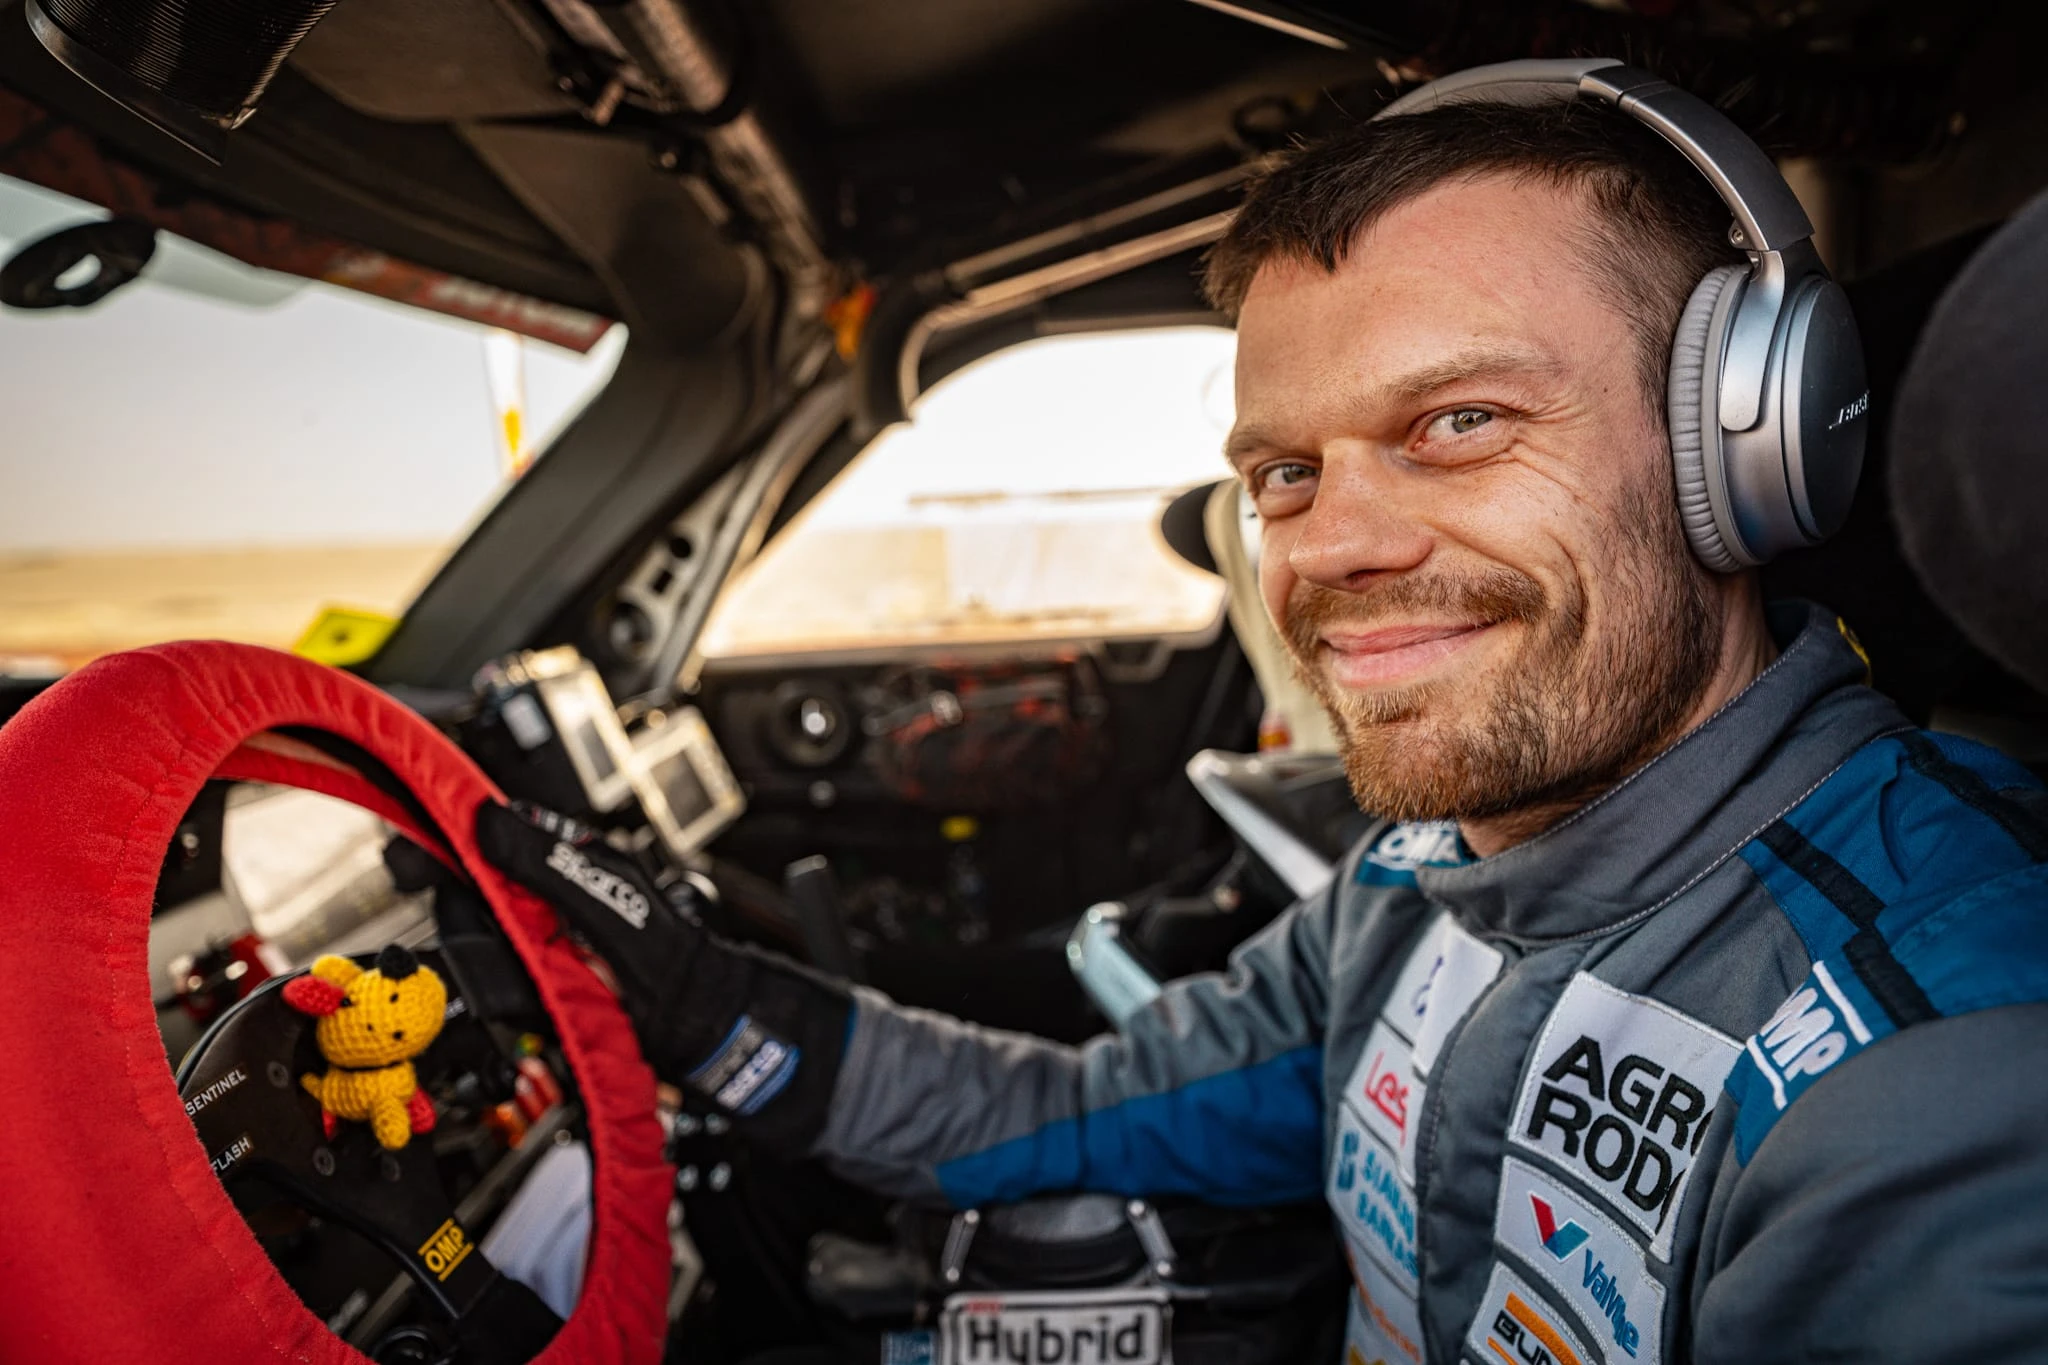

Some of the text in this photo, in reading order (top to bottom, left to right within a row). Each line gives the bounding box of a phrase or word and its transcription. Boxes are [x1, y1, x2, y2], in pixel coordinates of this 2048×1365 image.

[1760, 983, 1848, 1083] MP
[185, 1069, 246, 1116] SENTINEL
[1542, 1034, 1714, 1157] AGR
[210, 1137, 251, 1171] FLASH
[1527, 1082, 1686, 1235] ROD
[425, 1226, 464, 1273] OMP
[967, 1313, 1145, 1365] Hybrid
